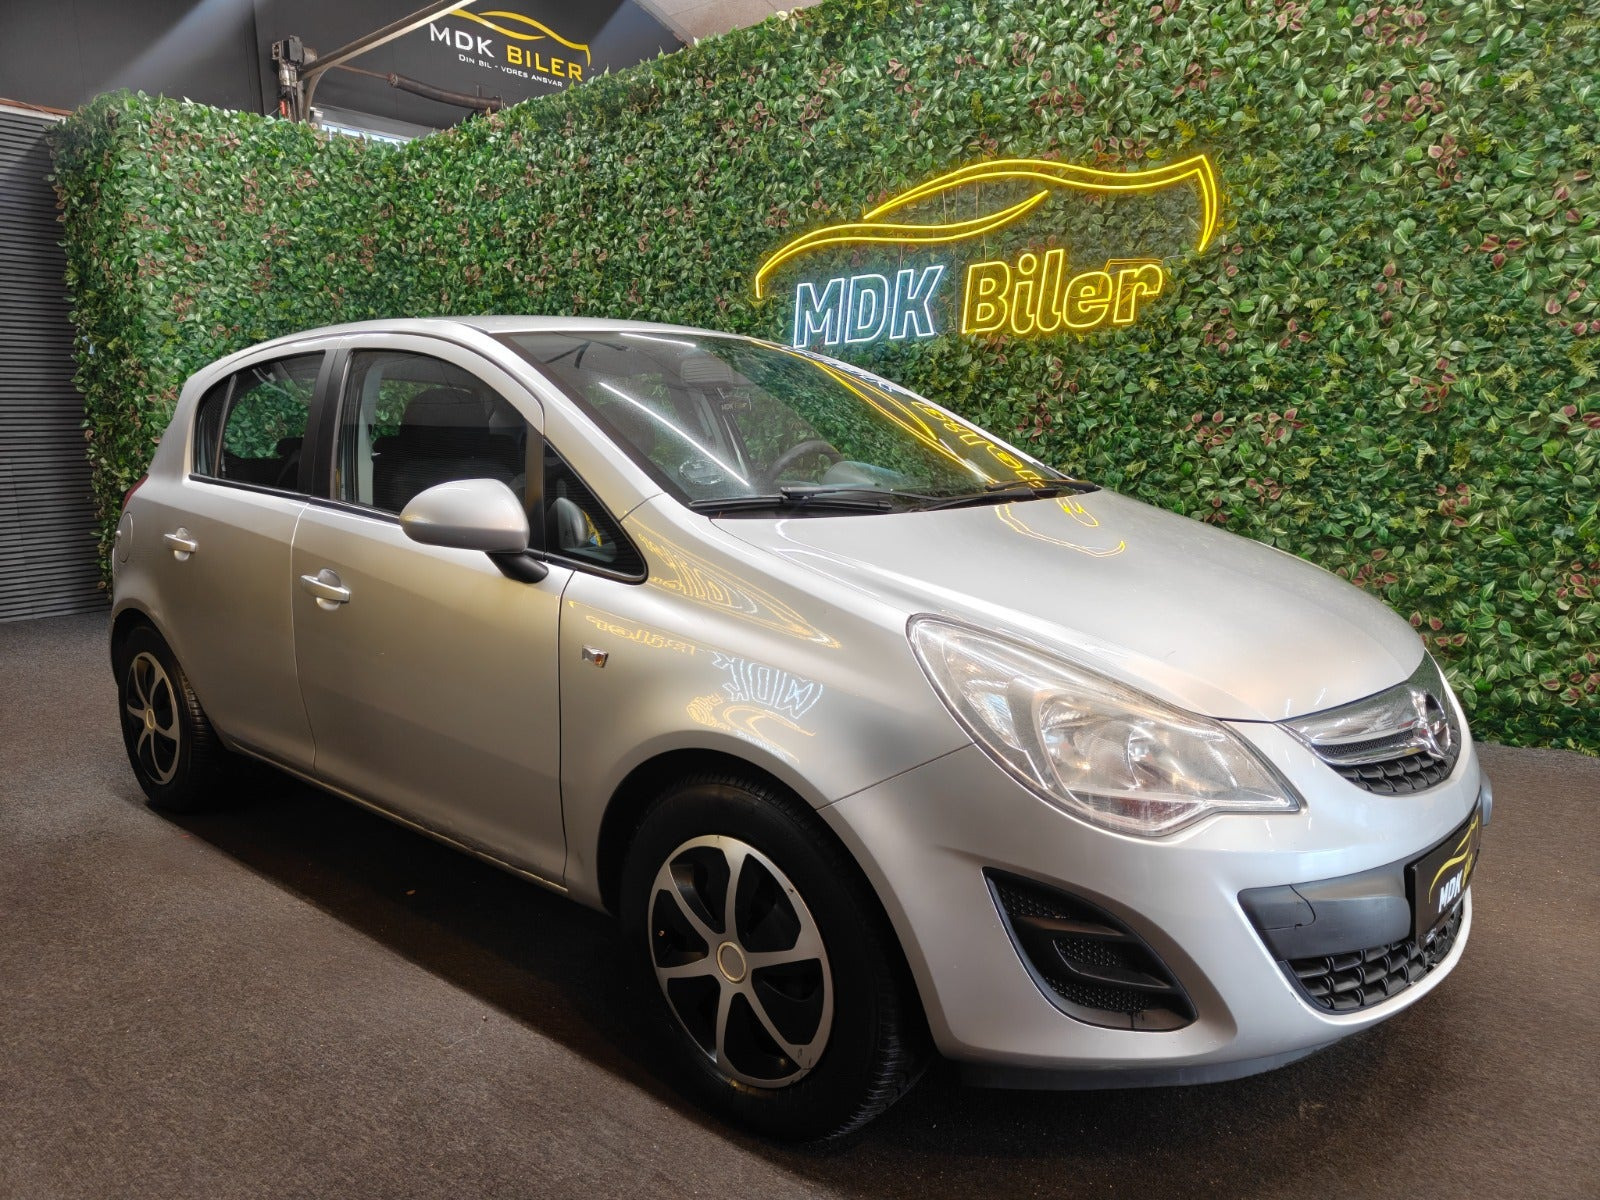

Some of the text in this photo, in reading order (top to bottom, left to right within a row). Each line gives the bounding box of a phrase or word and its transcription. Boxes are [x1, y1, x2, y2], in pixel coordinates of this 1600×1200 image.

[429, 22, 583, 82] MDK BILER
[478, 59, 493, 69] BIL
[500, 65, 528, 78] VORES
[531, 74, 563, 88] ANSVAR
[793, 248, 1164, 348] MDK Biler
[1438, 868, 1463, 913] MDK
